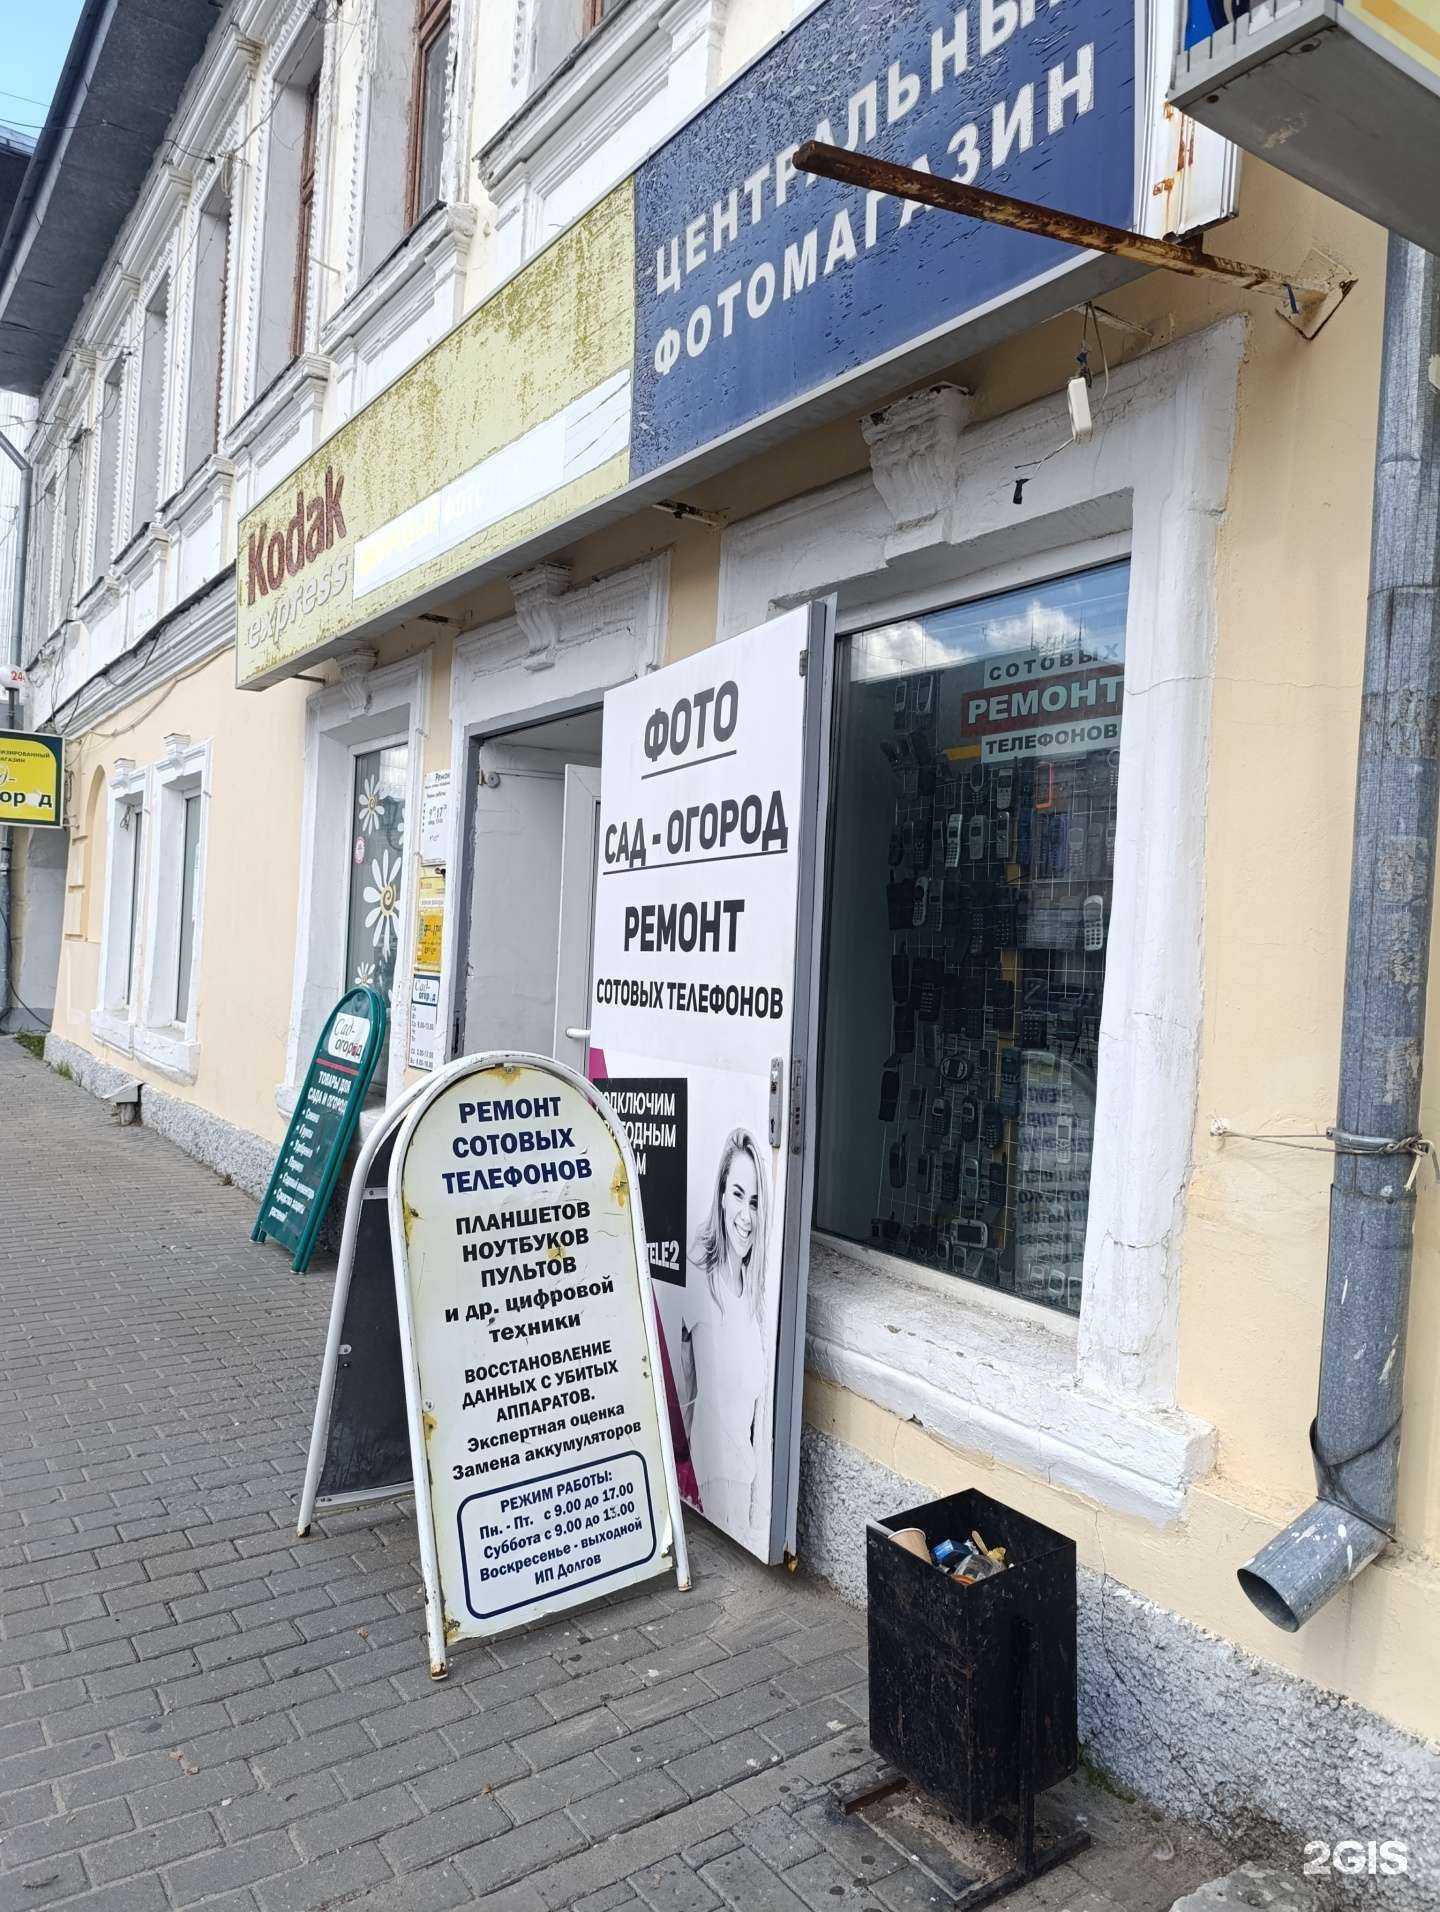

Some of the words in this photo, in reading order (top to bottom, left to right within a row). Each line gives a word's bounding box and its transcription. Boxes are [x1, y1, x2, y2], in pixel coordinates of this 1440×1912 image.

[656, 0, 1060, 295] ЦЕНТРЛЬНЫ
[247, 466, 347, 605] Kodak
[248, 554, 350, 648] express
[989, 643, 1119, 681] СОТОВЫХ
[644, 680, 739, 762] ФОТО
[968, 675, 1124, 724] РЕМОНТ
[985, 723, 1118, 755] ТЕЛЕФОНОВ
[624, 899, 745, 952] РЕМОНТ
[597, 978, 663, 1009] СОТОВЫХ
[667, 982, 784, 1019] ТЕЛЕФОНОВ
[459, 1097, 561, 1123] РЕМОНТ
[600, 1091, 676, 1117] ДКЛЮЧИМ
[452, 1128, 576, 1158] СОТОВЫХ
[442, 1158, 593, 1194] ТЕЛЕФОНОВ
[456, 1201, 591, 1235] ПЛАНШЕТОВ
[462, 1227, 590, 1262] НОУТБУКОВ
[648, 1240, 680, 1271] ELE2
[481, 1256, 577, 1288] ПУЛЬТОВ
[445, 1309, 459, 1322] и
[465, 1301, 499, 1322] др.
[505, 1275, 614, 1312] цифровой
[489, 1314, 581, 1343] техники
[464, 1340, 612, 1383] ВОССТАНОВЛЕНИЕ
[462, 1380, 537, 1410] ДАННЫХ
[541, 1375, 552, 1390] С
[557, 1360, 619, 1387] УБИТЫХ
[496, 1388, 596, 1422] АППАРАТОВ.
[467, 1419, 566, 1453] Экспертная
[570, 1403, 625, 1429] оценка
[453, 1454, 521, 1480] Замена
[525, 1421, 642, 1463] аккумуляторов
[479, 1525, 503, 1540] Пн.
[514, 1515, 534, 1531] Пт.
[554, 1498, 581, 1517] 9.00
[584, 1495, 599, 1510] до
[602, 1482, 634, 1502] 17.00
[500, 1486, 553, 1513] РЕЖИМ
[556, 1470, 613, 1497] РАБОТЫ:
[480, 1544, 571, 1582] Воскресенье
[581, 1517, 643, 1550] выходной
[483, 1534, 541, 1560] Суббота
[554, 1517, 582, 1537] 9.00
[585, 1514, 600, 1530] до
[534, 1566, 555, 1586] ИП
[557, 1553, 602, 1579] Долгов
